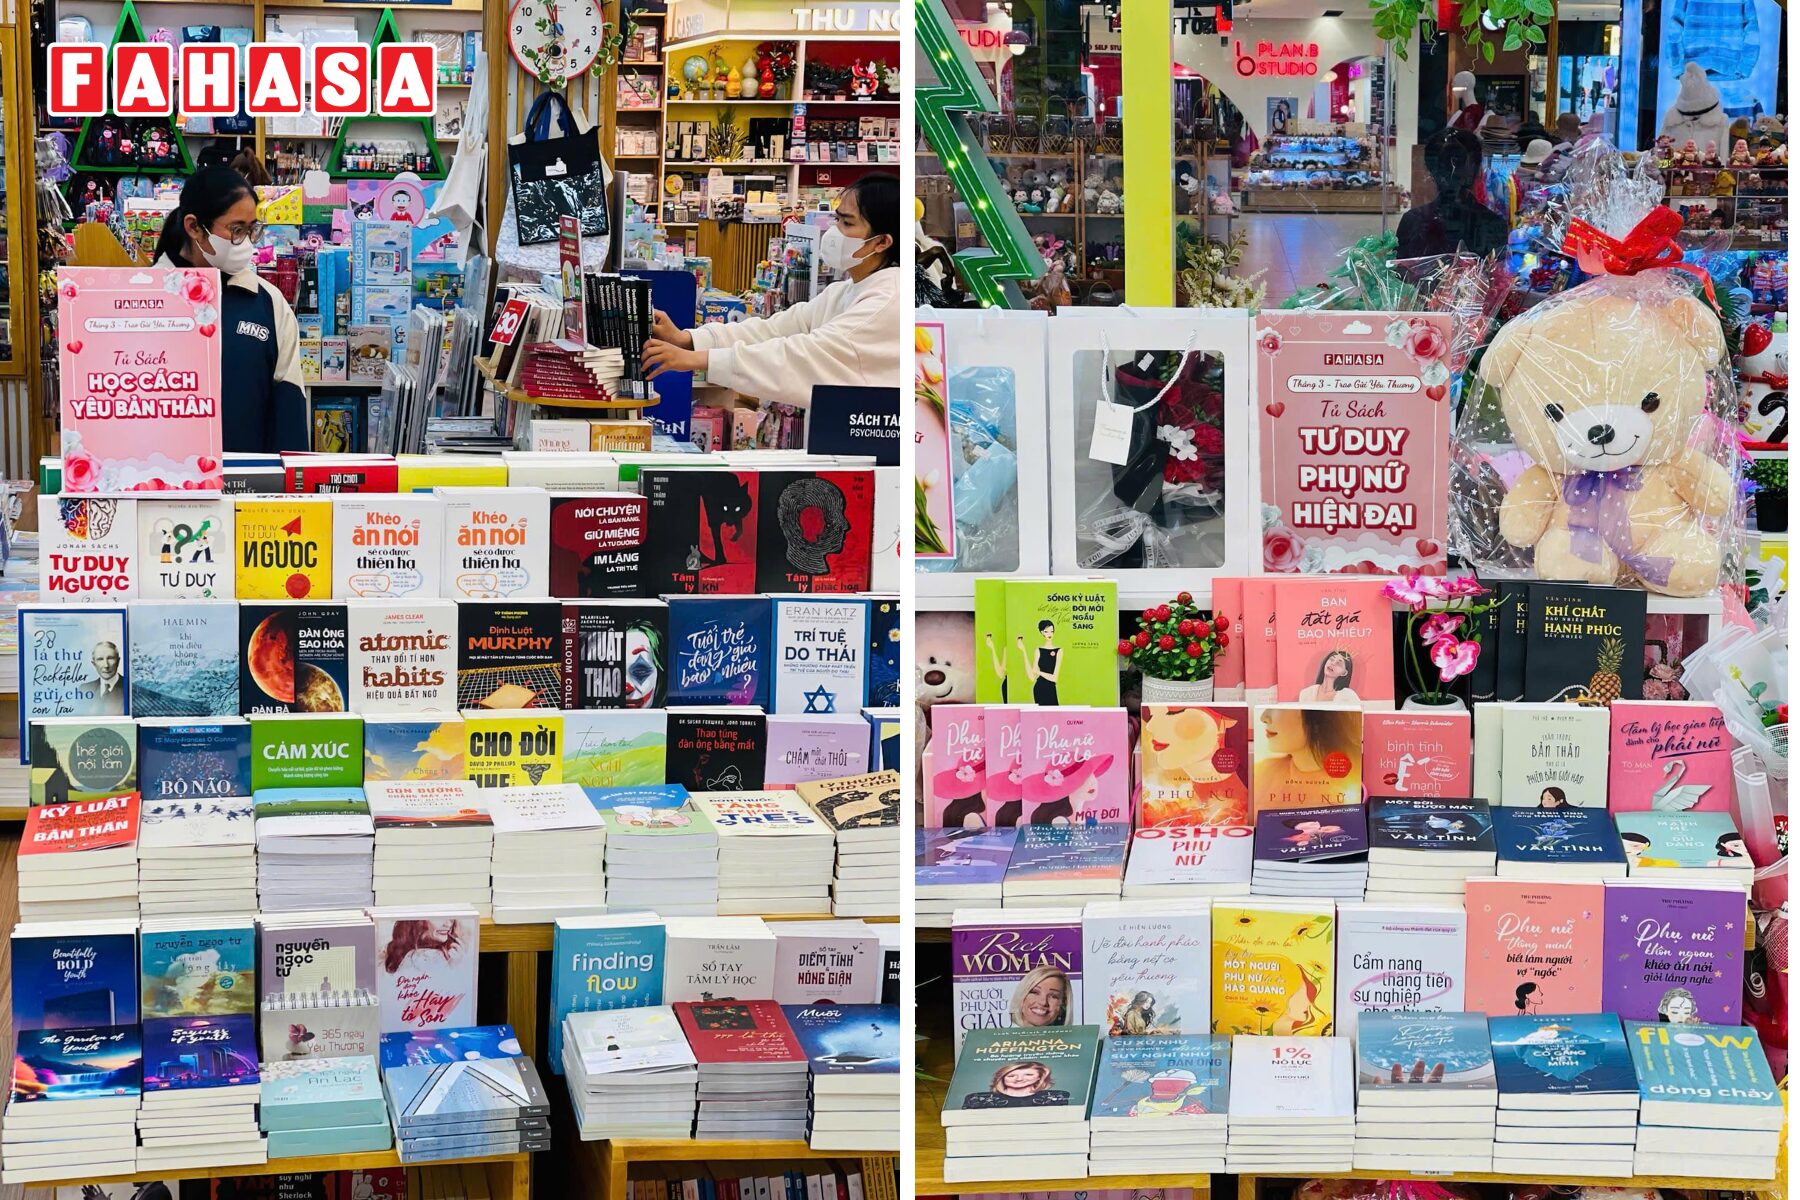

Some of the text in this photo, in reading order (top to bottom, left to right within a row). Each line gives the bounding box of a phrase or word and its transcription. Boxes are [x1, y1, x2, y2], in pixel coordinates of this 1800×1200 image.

[521, 7, 532, 17] 10
[585, 7, 592, 17] 2
[791, 8, 856, 32] THU
[515, 25, 523, 35] 9
[591, 26, 597, 36] 3
[956, 29, 1002, 48] TUDI
[584, 45, 591, 55] 4
[1258, 43, 1319, 58] PLAN.B
[570, 59, 577, 68] 5
[1258, 62, 1318, 76] STUDIO
[114, 299, 164, 309] FAHASA
[110, 320, 116, 329] 3
[236, 320, 270, 342] MNS
[113, 350, 168, 366] Tủ Sách
[1323, 353, 1384, 366] FAHASA
[88, 368, 198, 397] HỌC CÁCH
[1292, 378, 1316, 390] Tháng
[1318, 379, 1325, 389] 3
[1333, 378, 1352, 389] Trao
[1369, 378, 1386, 390] Yêu
[71, 395, 216, 420] YÊU BẢN THÂN
[1320, 399, 1387, 418] Tủ Sách
[849, 412, 881, 426] SÁCH
[849, 428, 900, 439] PSYCHOLOGY
[1298, 425, 1410, 456] TƯ DUY
[232, 479, 246, 489] TRÍ
[1298, 460, 1411, 499] PHỤ NỮ
[472, 511, 508, 525] Khéo
[574, 504, 641, 519] NÓI CHUYỆN
[1291, 498, 1417, 536] HIỆN ĐẠI
[366, 512, 401, 526] Khéo
[352, 524, 420, 547] ăn nói
[457, 523, 526, 546] ăn nói
[584, 527, 640, 541] GIỮ MIỆNG
[48, 554, 130, 573] TƯ DUY
[594, 552, 640, 565] IM LẶNG
[1087, 551, 1103, 564] YOU
[159, 571, 217, 588] TƯ DUY
[785, 606, 858, 618] ERAN KATZ
[298, 628, 345, 639] ĐÀN ÔNG
[489, 625, 534, 636] Định Luật
[793, 627, 847, 646] TRÍ TUỆ
[1297, 627, 1372, 639] BAO NHIÊU?
[359, 629, 450, 652] atomic
[468, 636, 553, 651] MURPHY
[784, 644, 856, 662] DO THÁI
[362, 666, 446, 688] habits
[695, 727, 739, 740] Thao túng
[469, 731, 513, 758] CHO
[518, 724, 556, 756] ĐỜI
[1387, 740, 1443, 752] bình tĩnh
[262, 740, 350, 760] CẢM XÚC
[1379, 757, 1397, 769] khi
[161, 777, 231, 798] BỘ NÃO
[1134, 827, 1255, 841] OSHO
[1390, 832, 1478, 842] VÃN TÌNH
[1561, 844, 1603, 852] TÌNH
[154, 935, 243, 952] nguyễn ngọc tư
[275, 938, 330, 954] nguyễn
[976, 931, 1054, 958] Rich
[56, 960, 94, 971] BOLD
[275, 953, 314, 968] ngọc
[571, 951, 654, 972] finding
[702, 960, 743, 972] SỔ TAY
[961, 952, 1072, 974] WOMAN
[1223, 959, 1281, 972] MỘT NGƯỜI
[1353, 951, 1423, 973] Cẩm nang
[1506, 953, 1573, 966] biết làm người
[586, 973, 638, 994] flow
[686, 974, 757, 986] TÂM LÝ HỌC
[321, 1028, 365, 1042] 365 ngày
[306, 1040, 365, 1053] Yêu Thương
[975, 1043, 1082, 1054] HUFFINGTON
[990, 1038, 1064, 1048] ARIANNA
[1271, 1047, 1312, 1060] 1%
[1547, 1059, 1579, 1067] MÌNH
[278, 1174, 292, 1183] suy
[278, 1191, 313, 1199] Sherlock
